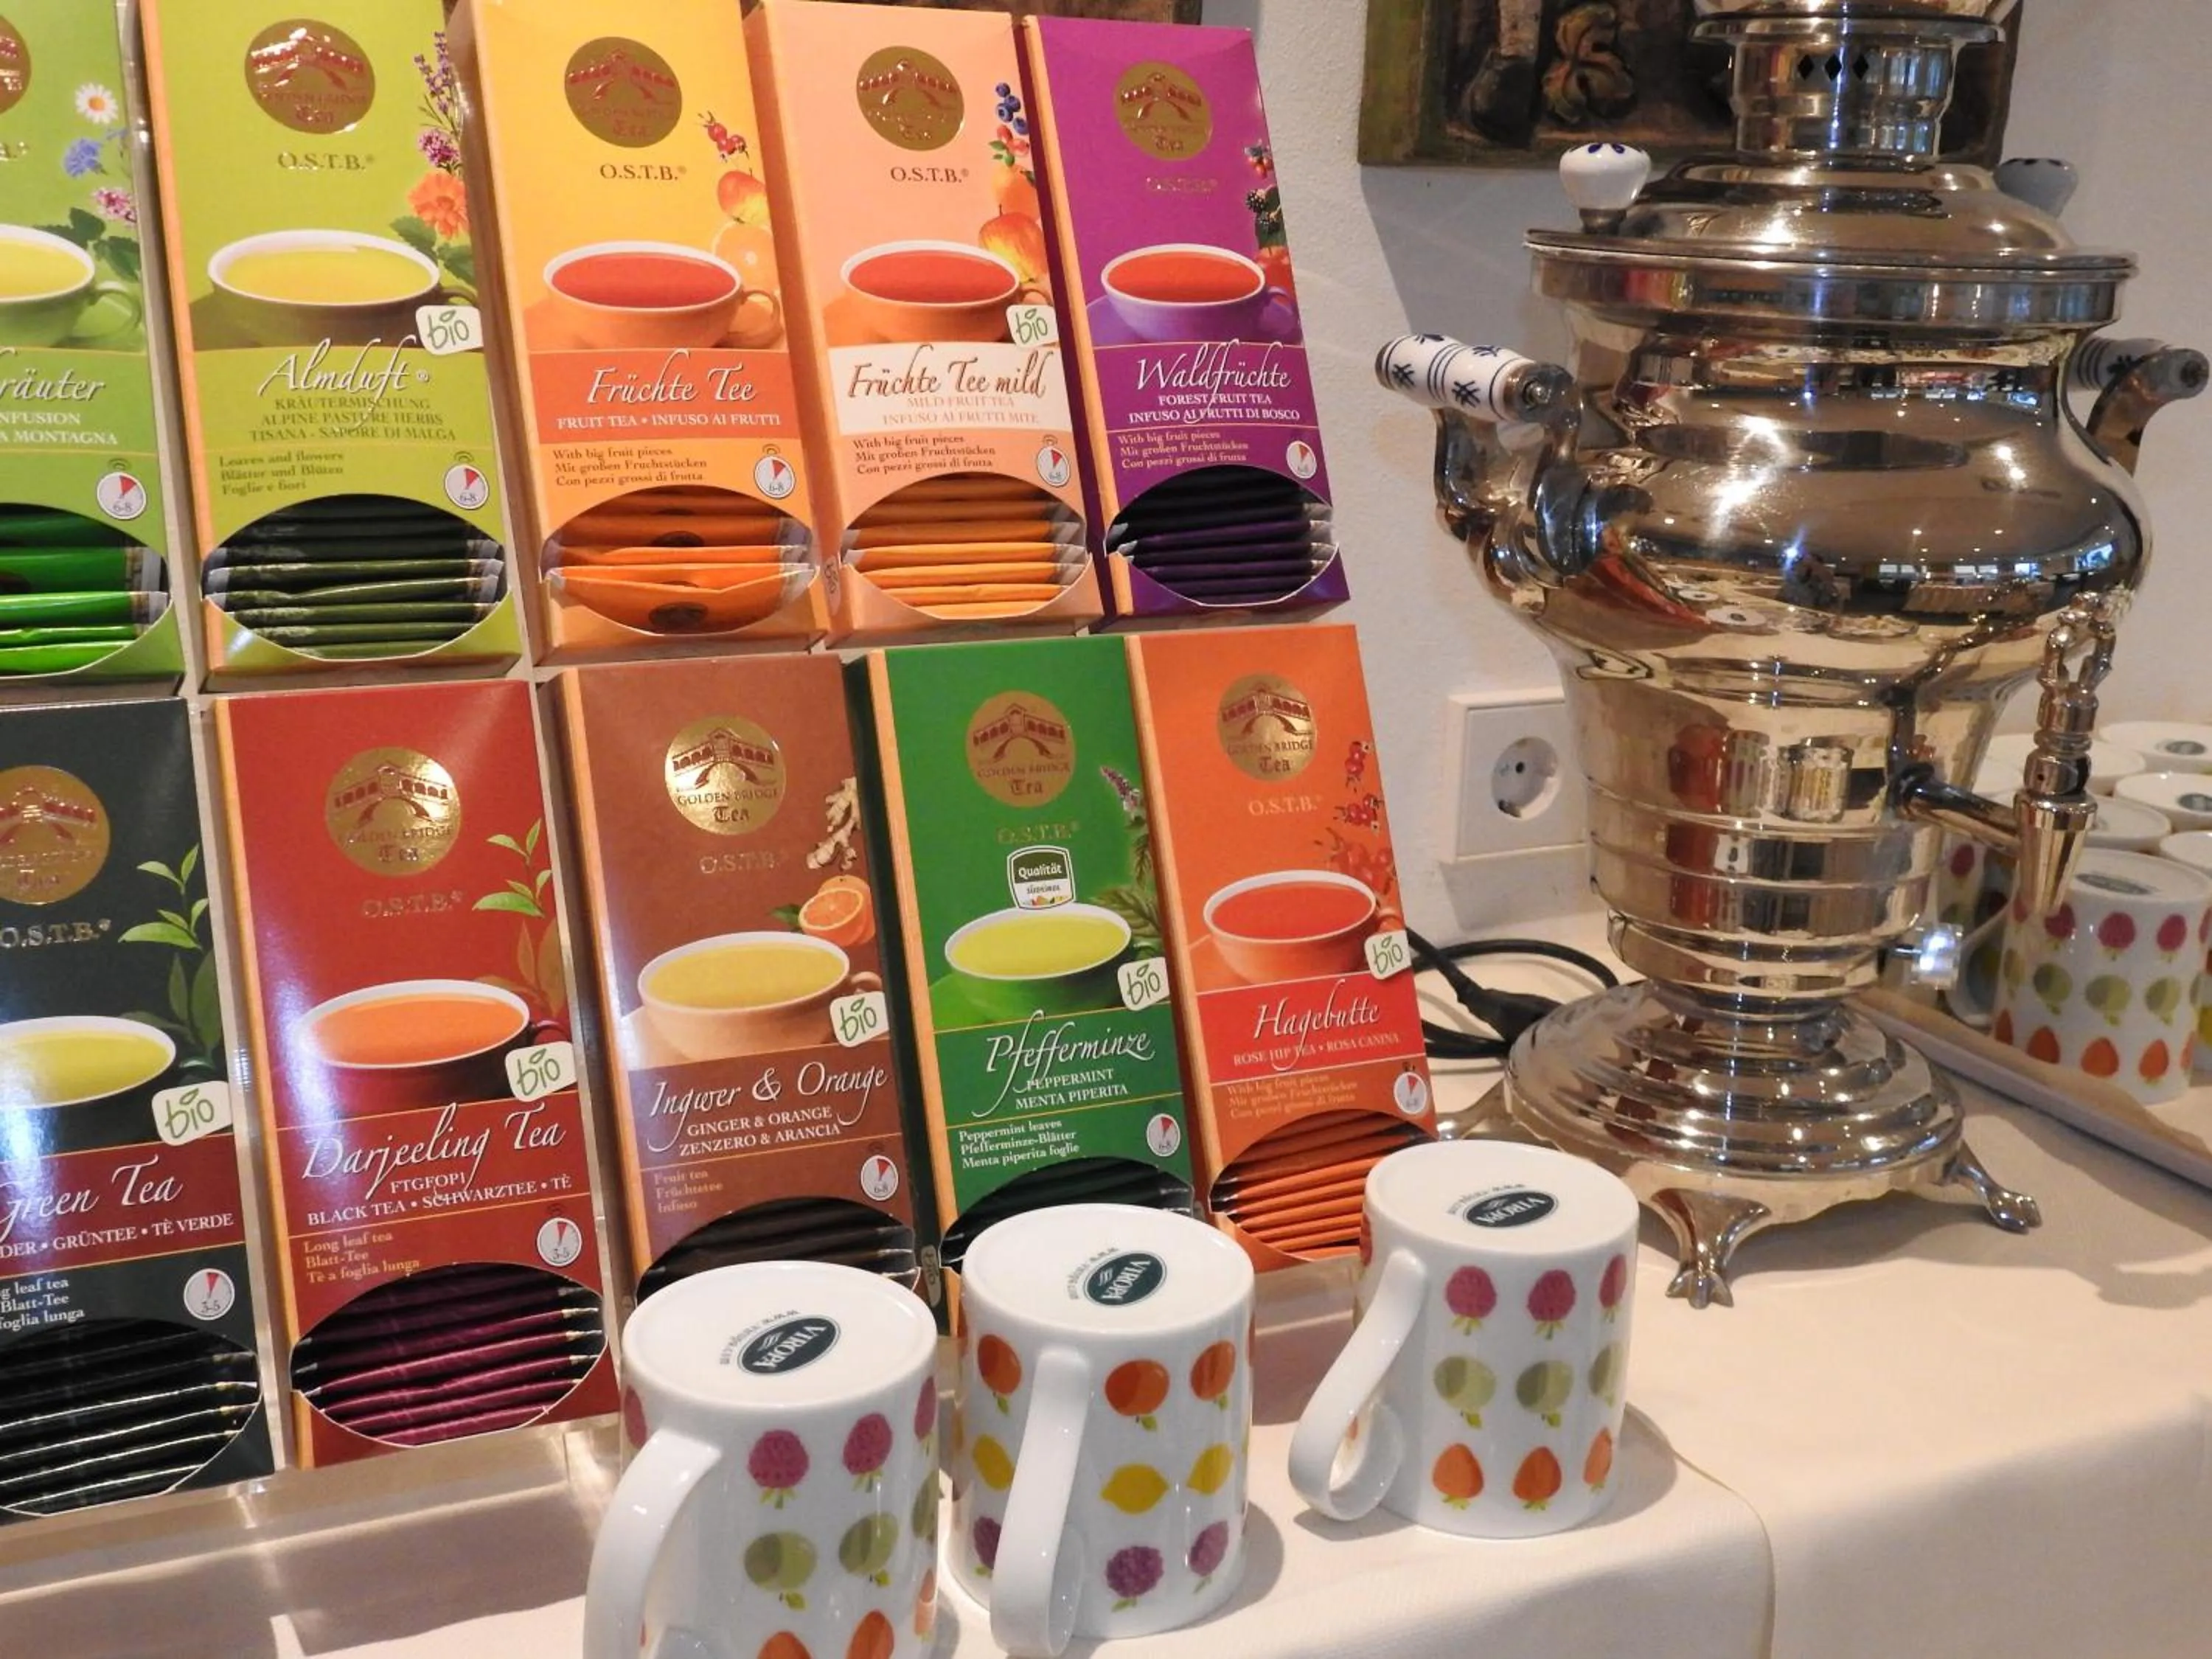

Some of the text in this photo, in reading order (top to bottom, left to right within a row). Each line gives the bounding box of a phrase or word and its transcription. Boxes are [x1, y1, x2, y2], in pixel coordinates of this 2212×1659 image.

[588, 349, 757, 404] Früchte Tee
[848, 344, 1054, 398] Früchte Tee mild
[276, 397, 431, 411] KRÄUTERMISCHUNG
[908, 397, 1015, 408] MILD FRUIT TEA
[1158, 393, 1272, 406] FOREST FRUIT TEA
[262, 410, 443, 426] ALPINE PASTURE HERBS
[557, 414, 781, 430] FRUIT TEA INFUSO AI FRUTTI
[1129, 408, 1300, 423] INFUSO AI FRUTTI DI BOSCO
[13, 431, 118, 445] MONTAGNA
[250, 428, 456, 442] TISANA SAPORE DI MALGA
[853, 434, 964, 449] With big fruit pieces
[220, 451, 344, 467] Leaves and flowers
[554, 447, 672, 461] With big fruit pieces
[856, 452, 874, 462] Mit
[221, 468, 267, 481] Blätter
[271, 467, 296, 478] und
[555, 463, 577, 473] Mit
[581, 460, 621, 475] großen
[857, 465, 880, 474] Con
[883, 463, 911, 476] pezzi
[222, 483, 265, 496] Foglie
[277, 481, 306, 491] fiori
[557, 472, 703, 487] Con pezzi grossi di frutta
[677, 790, 730, 806] GOLDEN
[1019, 863, 1062, 880] Qualität
[840, 998, 877, 1042] bio
[1234, 1032, 1399, 1066] ROSE HIP TEA ROSA CANINA
[517, 1048, 560, 1096] bio
[971, 1009, 1155, 1118] Pfefferminze
[1026, 1068, 1114, 1092] PEPPERMINT
[647, 1061, 888, 1151] Ingwer & Orange
[1015, 1084, 1128, 1110] MENTA PIPERITA
[165, 1088, 215, 1139] bio
[687, 1105, 832, 1137] GINGER & ORANGE
[679, 1123, 841, 1157] ZENZERO & ARANCIA
[959, 1121, 1062, 1145] Peppermint leaves
[302, 1102, 567, 1201] Darjeeling Tea
[962, 1143, 1079, 1169] Menta piperita foglie
[111, 1154, 184, 1206] Tea
[654, 1169, 709, 1185] Fruit tea
[308, 1172, 572, 1226] BLACK TEA SCHWARZTEE TÈ
[1475, 1197, 1546, 1223] VIROPA
[53, 1225, 138, 1251] GRÜNTEE
[151, 1218, 175, 1237] TÈ
[177, 1213, 234, 1234] VERDE
[304, 1230, 394, 1253] Long leaf tea
[306, 1251, 369, 1270] Blatt-Tee
[327, 1272, 337, 1281] a
[341, 1264, 378, 1282] foglia
[383, 1259, 420, 1274] lunga
[14, 1279, 69, 1295] leaf tea
[1101, 1260, 1152, 1300] VIROPA
[1, 1293, 70, 1314] Blatt-Tee
[44, 1308, 85, 1324] lunga
[752, 1326, 827, 1368] VIROPA
